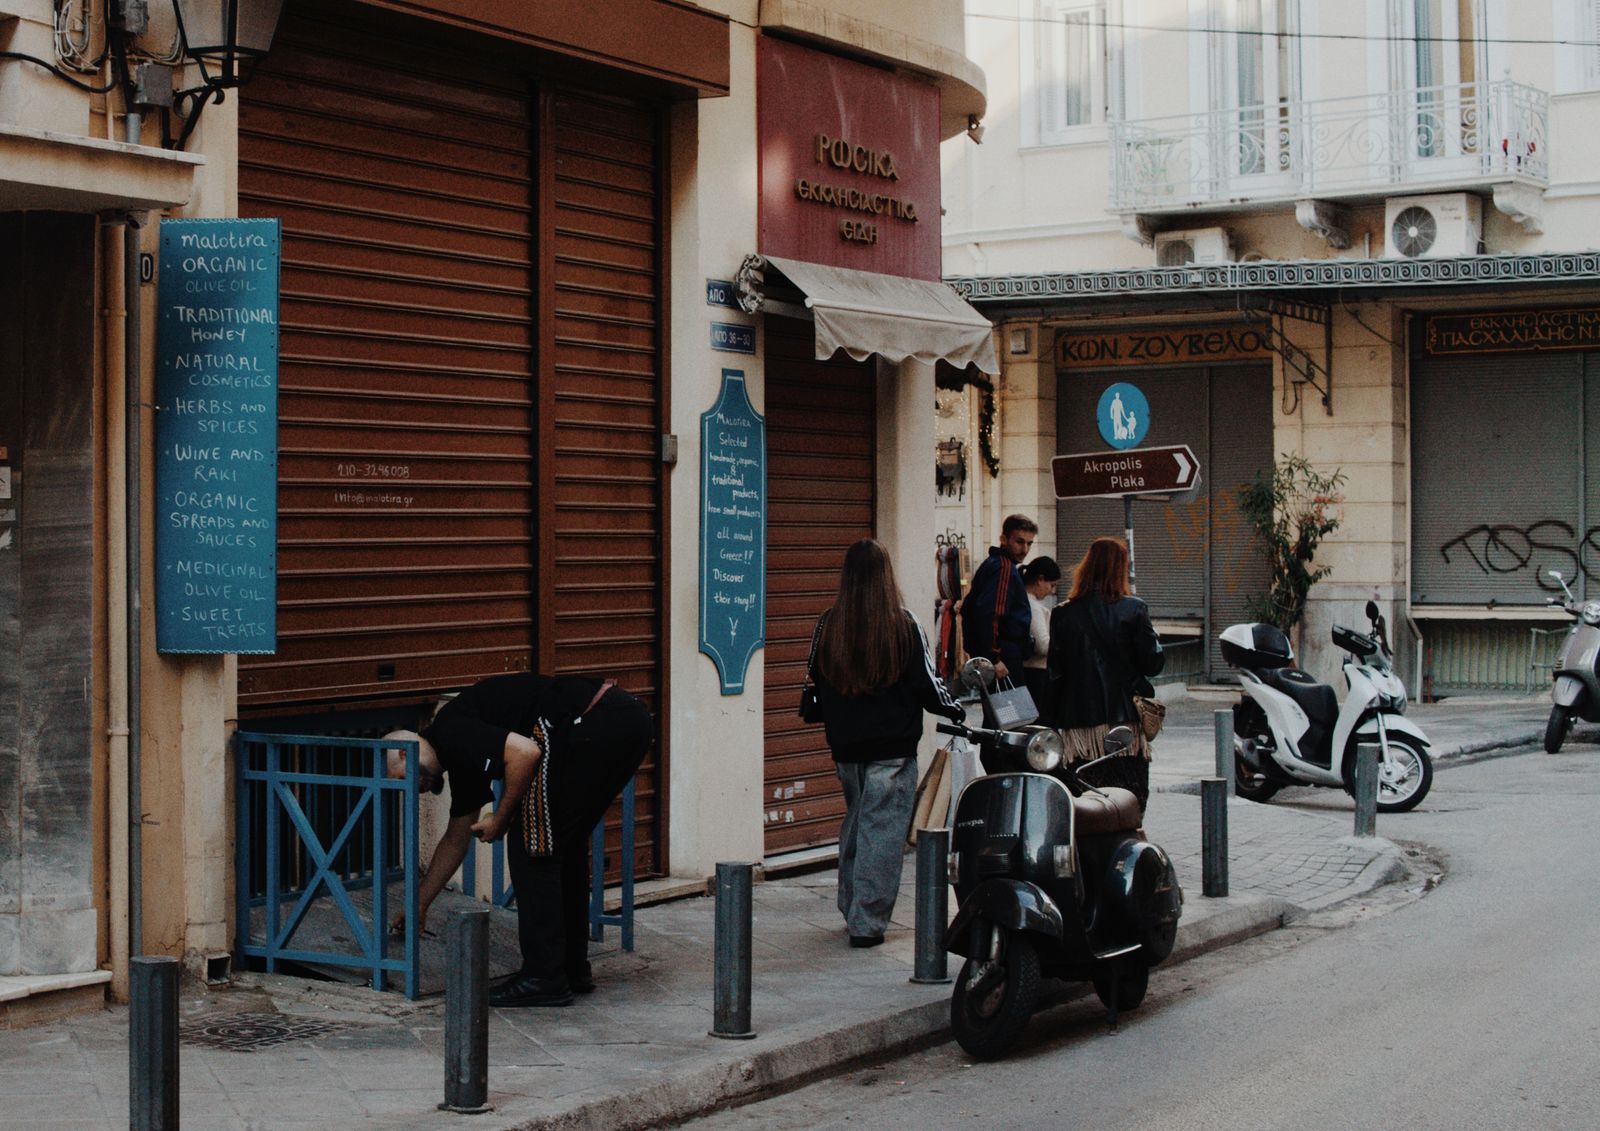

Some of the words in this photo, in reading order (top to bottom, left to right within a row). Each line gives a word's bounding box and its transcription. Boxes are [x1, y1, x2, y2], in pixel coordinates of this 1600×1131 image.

[181, 233, 267, 249] malotira
[182, 257, 267, 273] ORGANIC
[185, 280, 225, 293] OLIVE
[230, 280, 256, 292] OIL
[173, 306, 276, 324] TRADITIONAL
[191, 328, 246, 343] HONEY
[175, 353, 264, 371] NATURAL
[189, 374, 271, 388] COSMETICS
[175, 397, 233, 415] HERBS
[240, 401, 266, 412] AND
[198, 419, 257, 434] SPICES
[719, 432, 747, 448] Selected
[175, 444, 221, 461] WINE
[230, 449, 264, 461] AND
[1084, 457, 1142, 473] Akropolis
[194, 465, 237, 482] RAKI
[712, 473, 744, 487] traditional
[1111, 475, 1145, 488] Plaka
[174, 491, 257, 512] ORGANIC
[708, 500, 721, 513] from
[722, 505, 737, 515] small
[170, 512, 235, 529] SPREADS
[242, 518, 269, 529] AND
[196, 531, 256, 547] SAUCES
[717, 527, 730, 540] all
[733, 529, 753, 542] around
[177, 561, 267, 579] MEDICINAL
[712, 568, 745, 583] Discover
[185, 582, 232, 599] OLIVE
[240, 588, 265, 601] OIL
[713, 591, 731, 604] their
[182, 606, 243, 621] SWEET
[203, 623, 266, 640] TREATS
